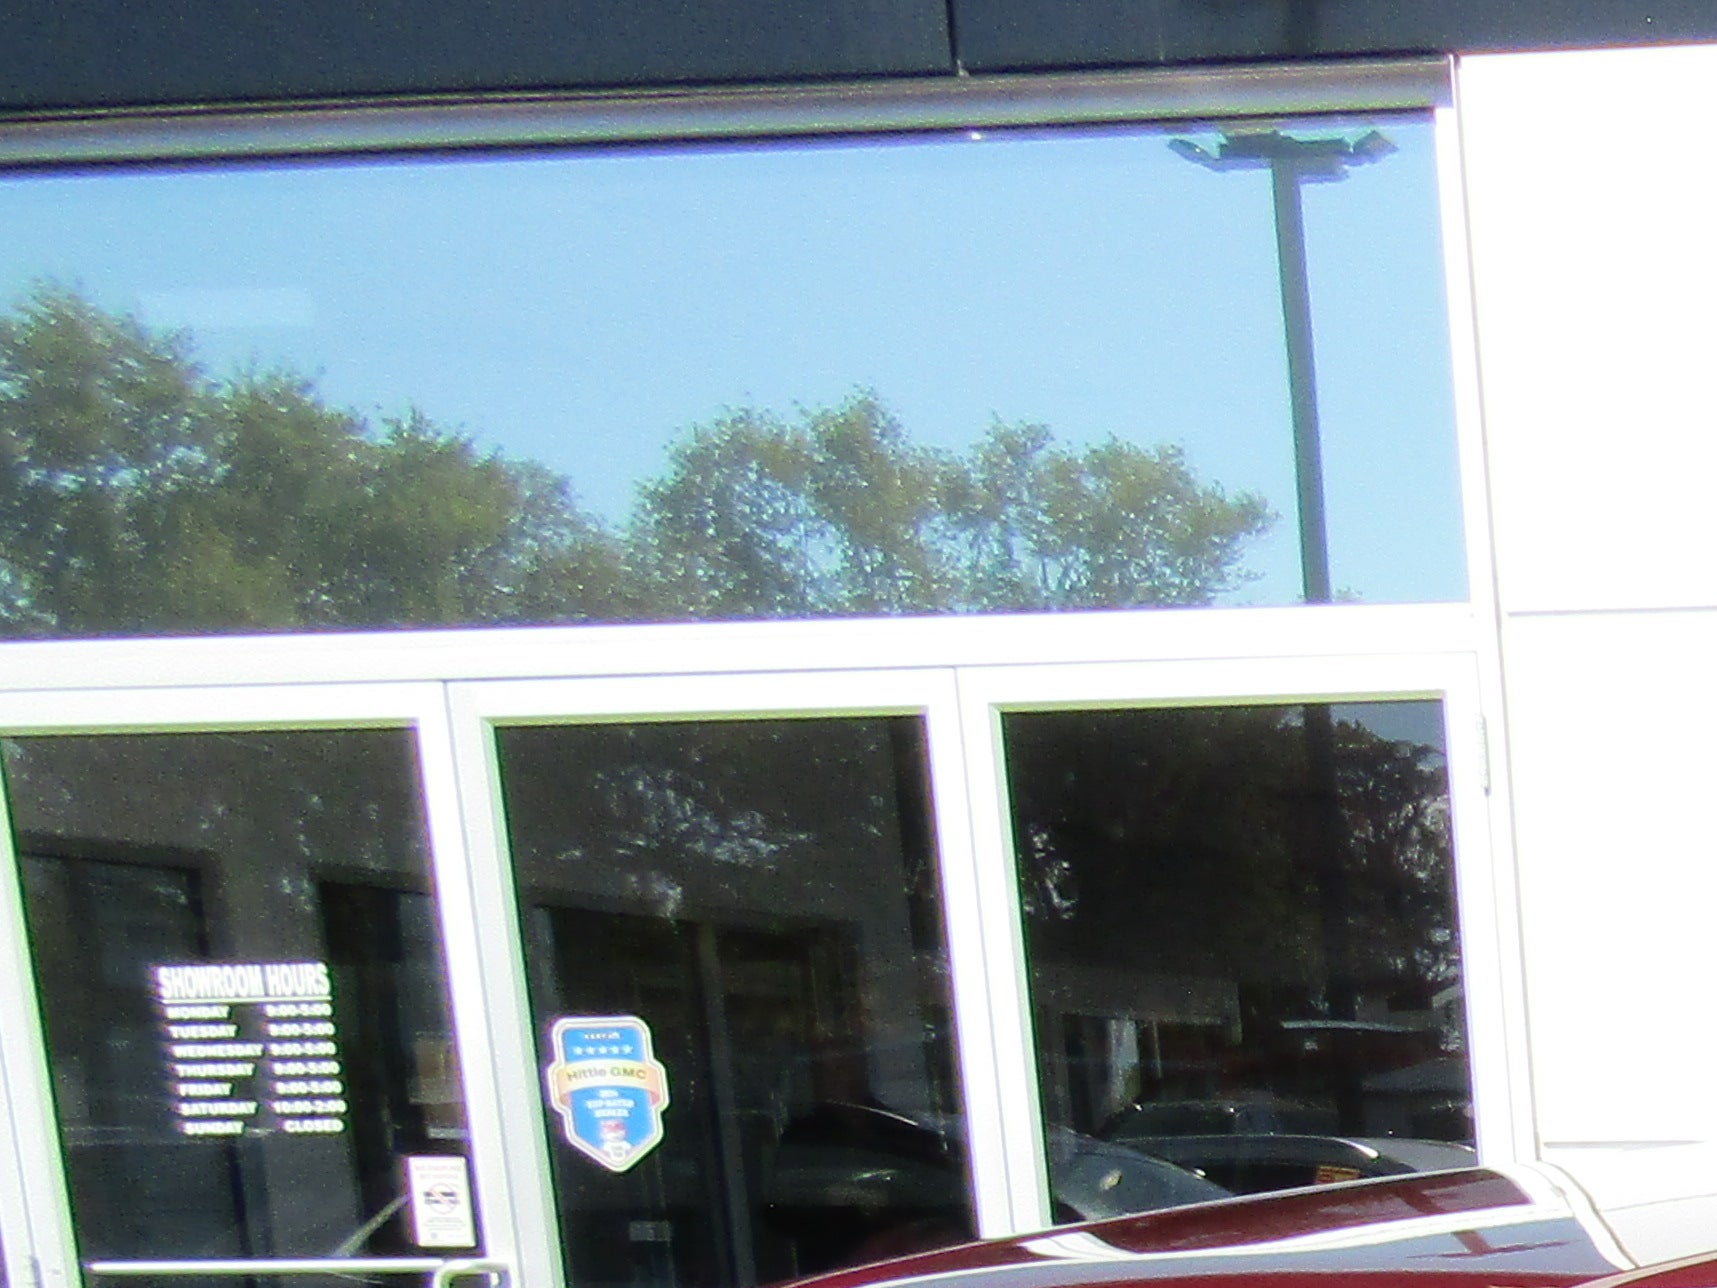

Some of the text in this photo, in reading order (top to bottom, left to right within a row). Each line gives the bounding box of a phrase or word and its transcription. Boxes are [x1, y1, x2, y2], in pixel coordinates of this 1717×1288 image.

[158, 962, 331, 998] SHOWROOM HOURS
[165, 1004, 231, 1019] MONDAY
[168, 1023, 238, 1039] TUESDAY
[171, 1043, 264, 1058] WEDNESDAY
[174, 1062, 256, 1077] THURSDAY
[566, 1066, 647, 1081] Hittle GMC
[178, 1081, 233, 1096] FRIDAY
[180, 1101, 259, 1116] SATURDAY
[183, 1120, 246, 1135] SUNDAY
